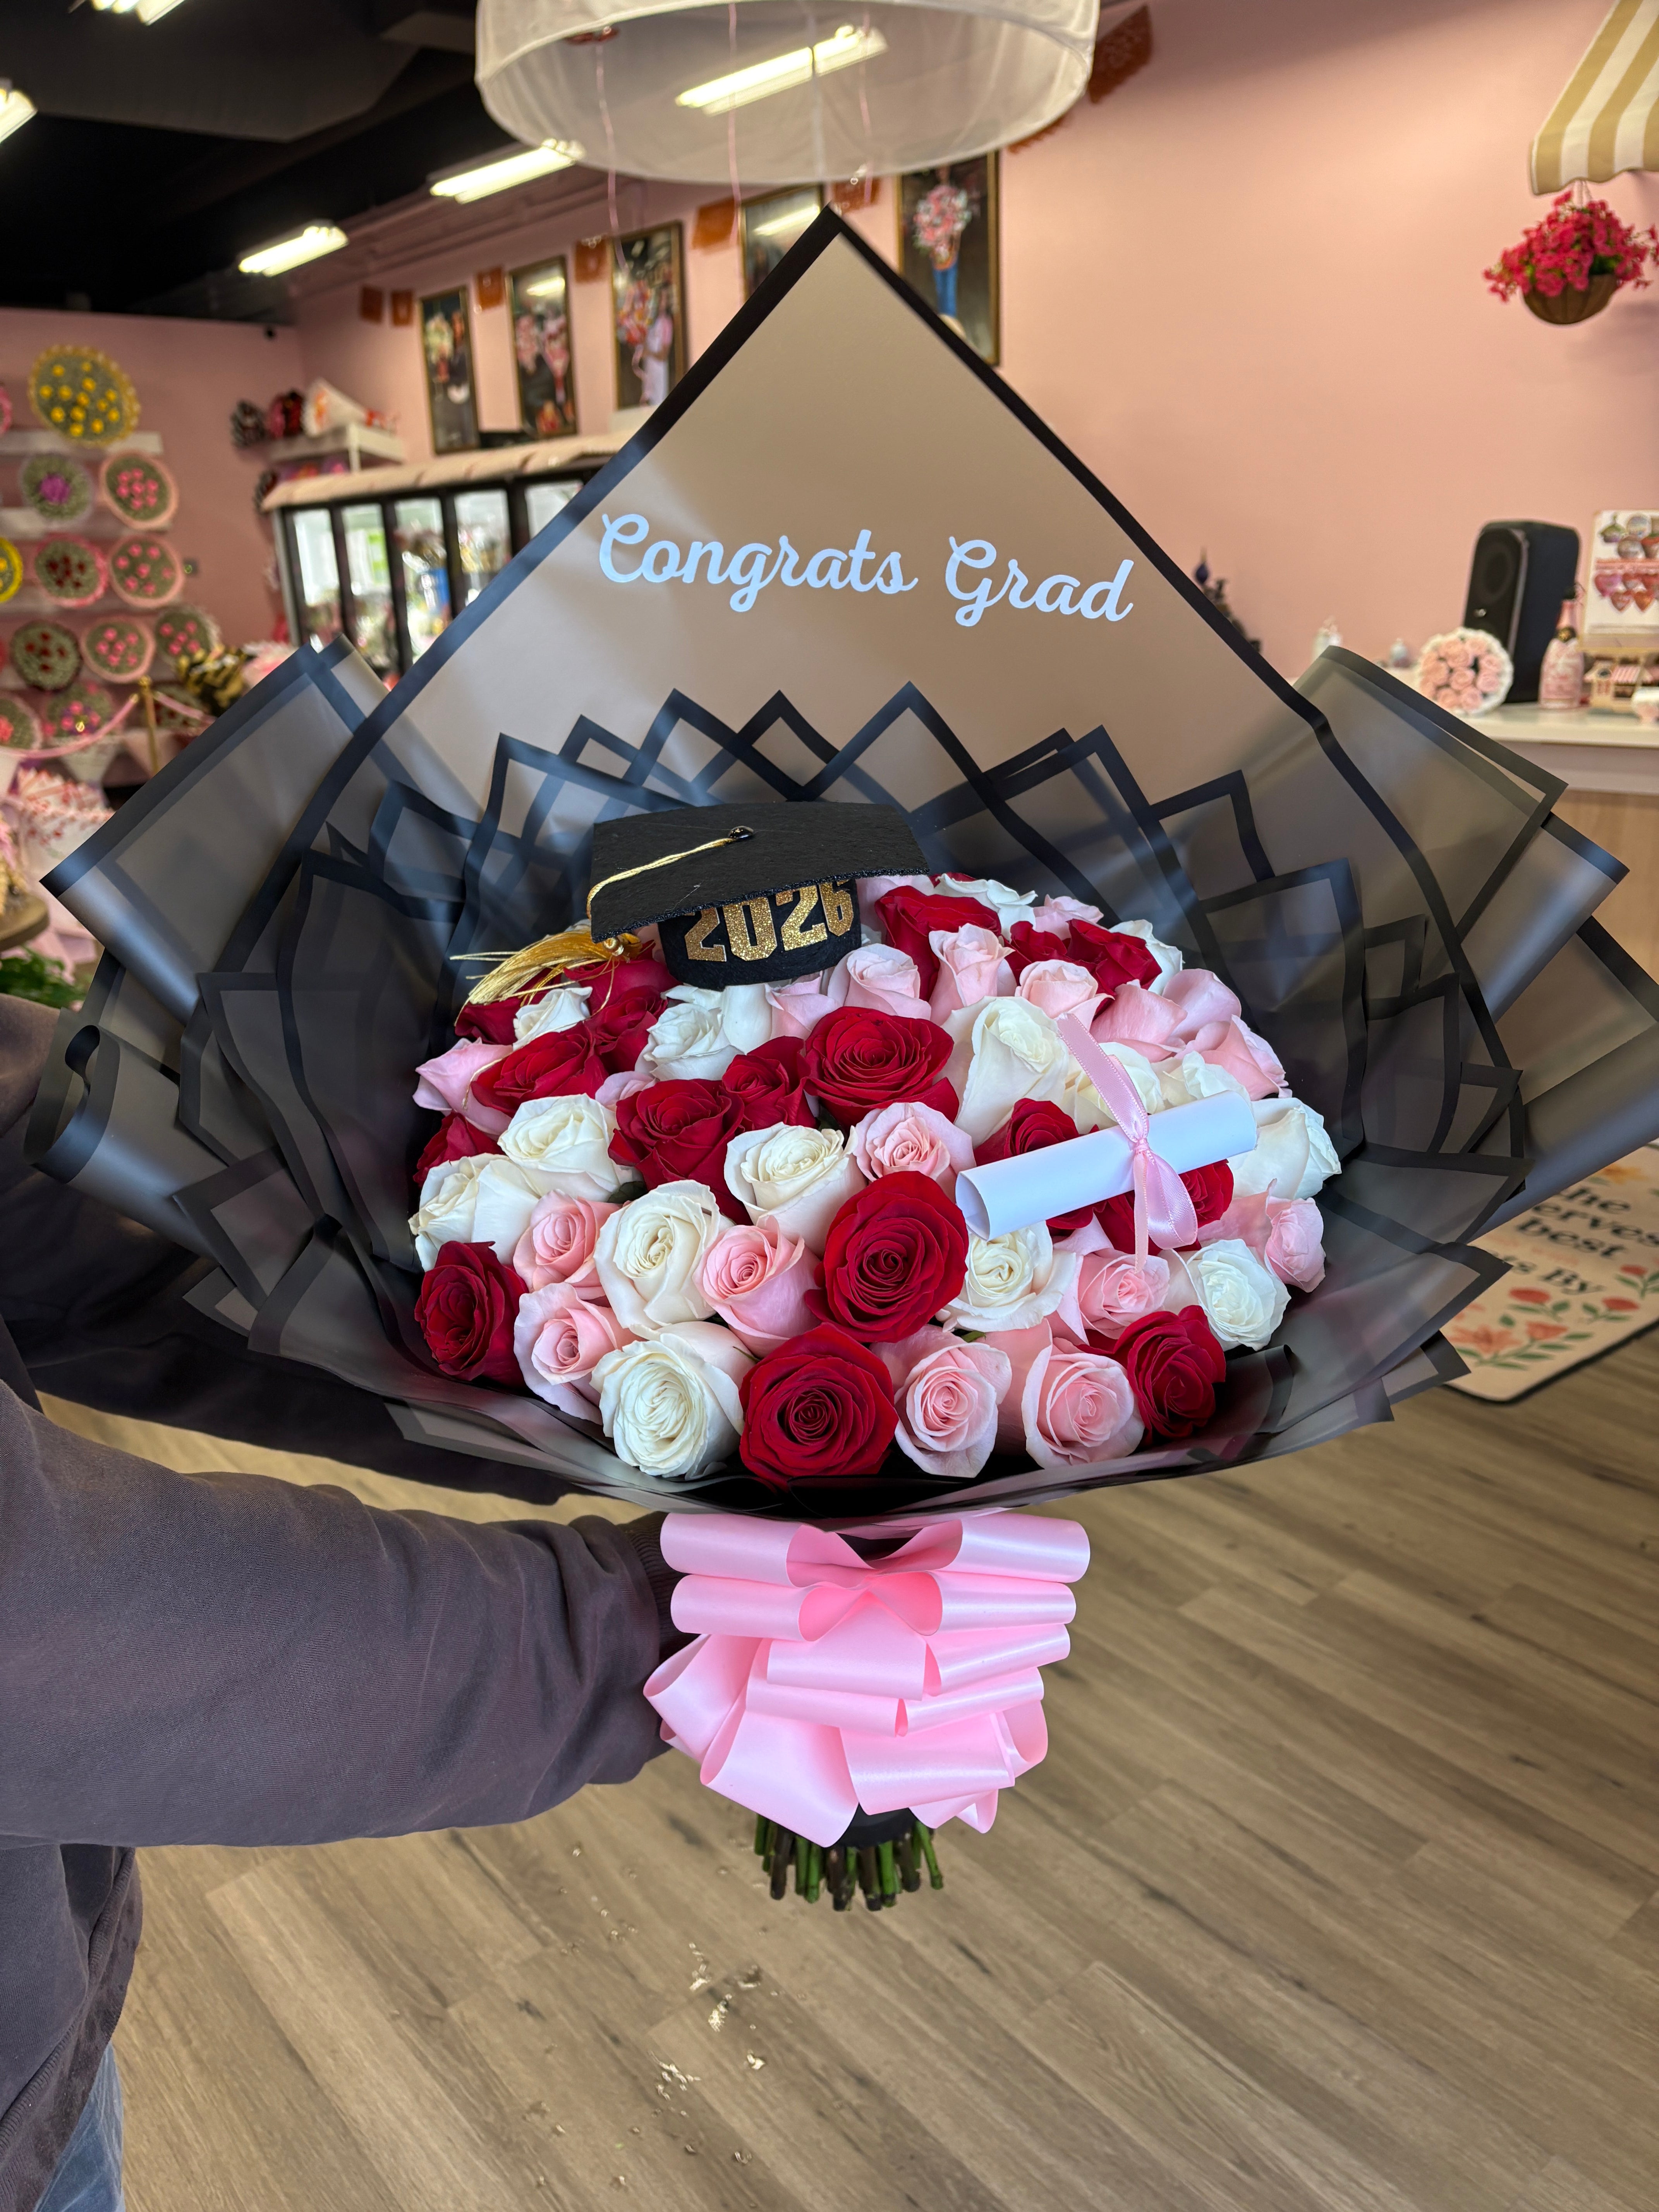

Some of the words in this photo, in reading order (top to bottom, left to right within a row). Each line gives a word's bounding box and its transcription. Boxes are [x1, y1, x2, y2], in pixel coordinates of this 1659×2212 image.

[598, 513, 918, 613] Congrats
[945, 537, 1134, 627] Grad
[684, 879, 854, 962] 2026
[1516, 1217, 1628, 1262] best
